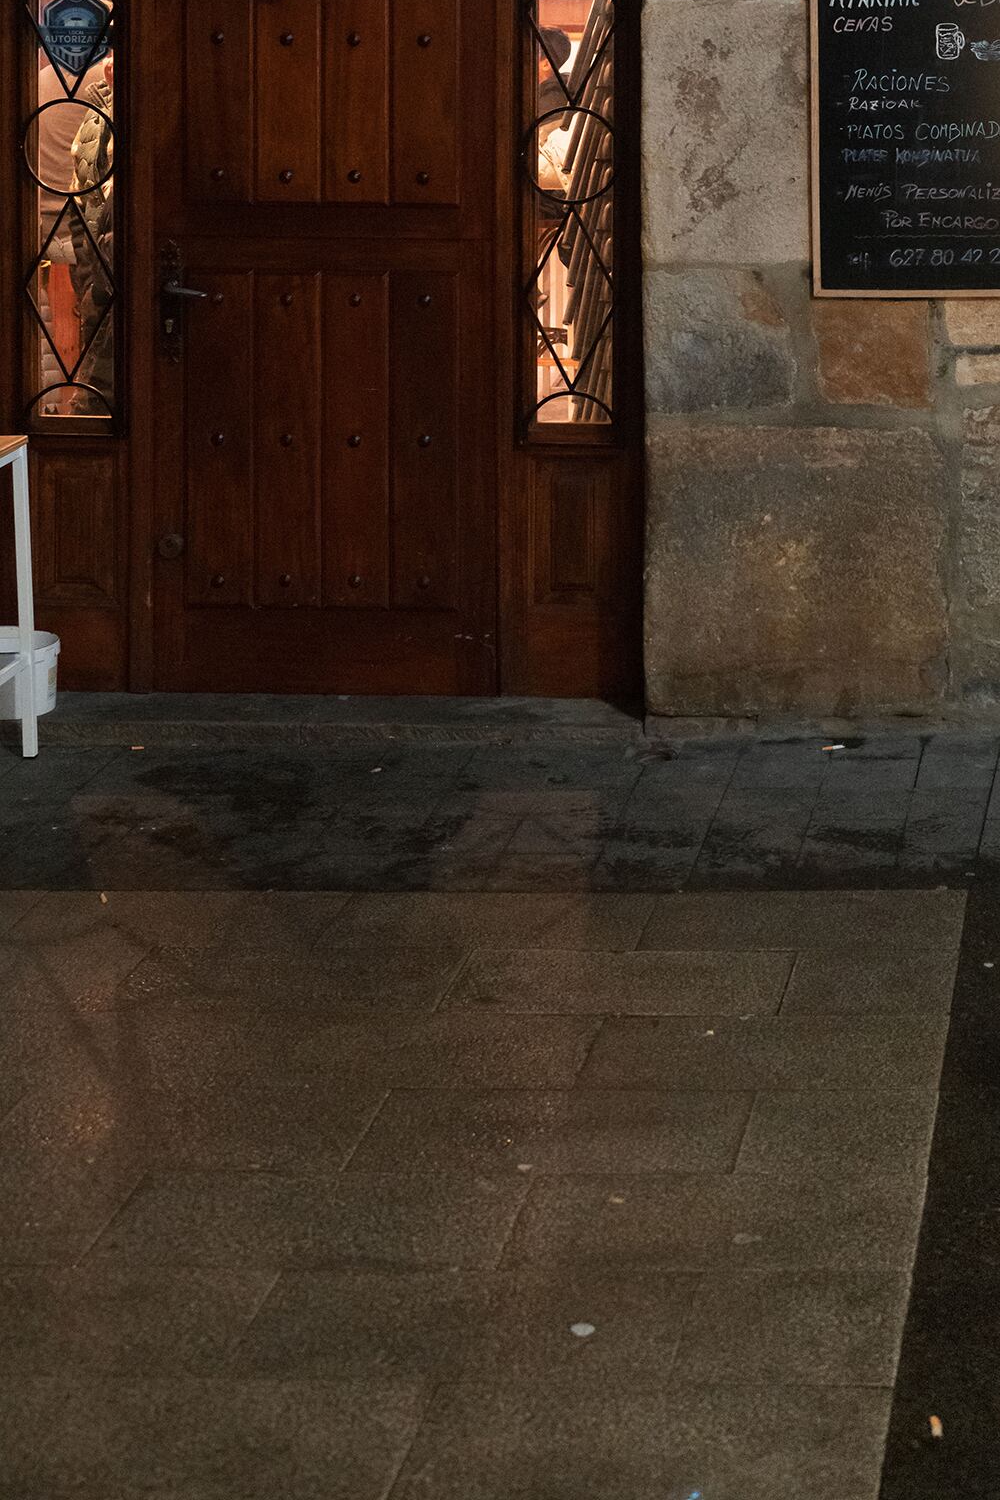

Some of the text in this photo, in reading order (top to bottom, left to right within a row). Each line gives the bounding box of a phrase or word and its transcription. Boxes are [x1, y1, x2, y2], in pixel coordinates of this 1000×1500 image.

[833, 16, 894, 33] CENAS
[850, 67, 951, 94] RACIONES
[847, 96, 922, 113] RAZIOAK
[847, 124, 905, 140] PLATOS
[880, 209, 1000, 230] POR ENCARGO
[889, 249, 926, 268] 627
[930, 248, 955, 266] 80
[960, 248, 983, 262] 42
